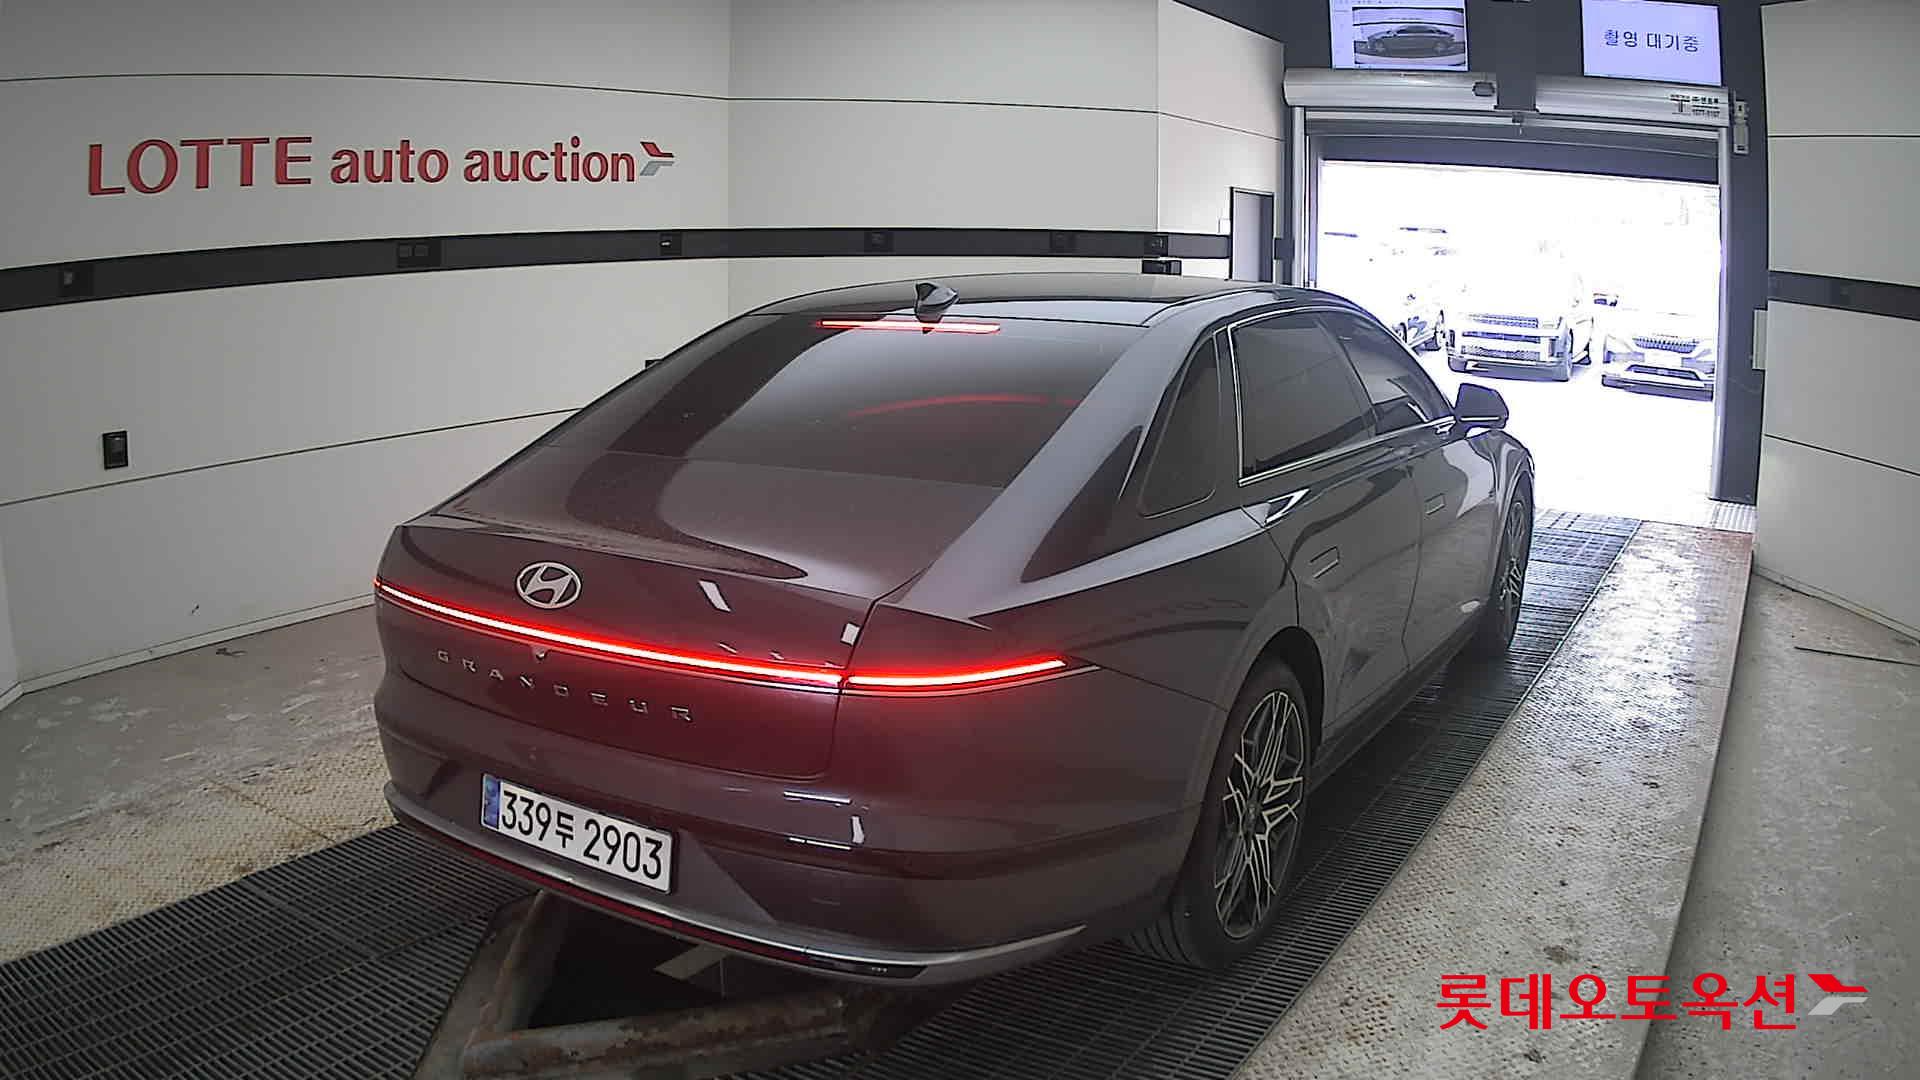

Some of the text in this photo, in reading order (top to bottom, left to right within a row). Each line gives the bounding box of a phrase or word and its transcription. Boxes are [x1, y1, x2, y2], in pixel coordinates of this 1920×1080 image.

[1646, 33, 1699, 52] 대기중
[88, 136, 636, 196] LOTTE auto auction
[437, 649, 691, 722] GRANDEUR
[502, 789, 663, 880] 339두 2903
